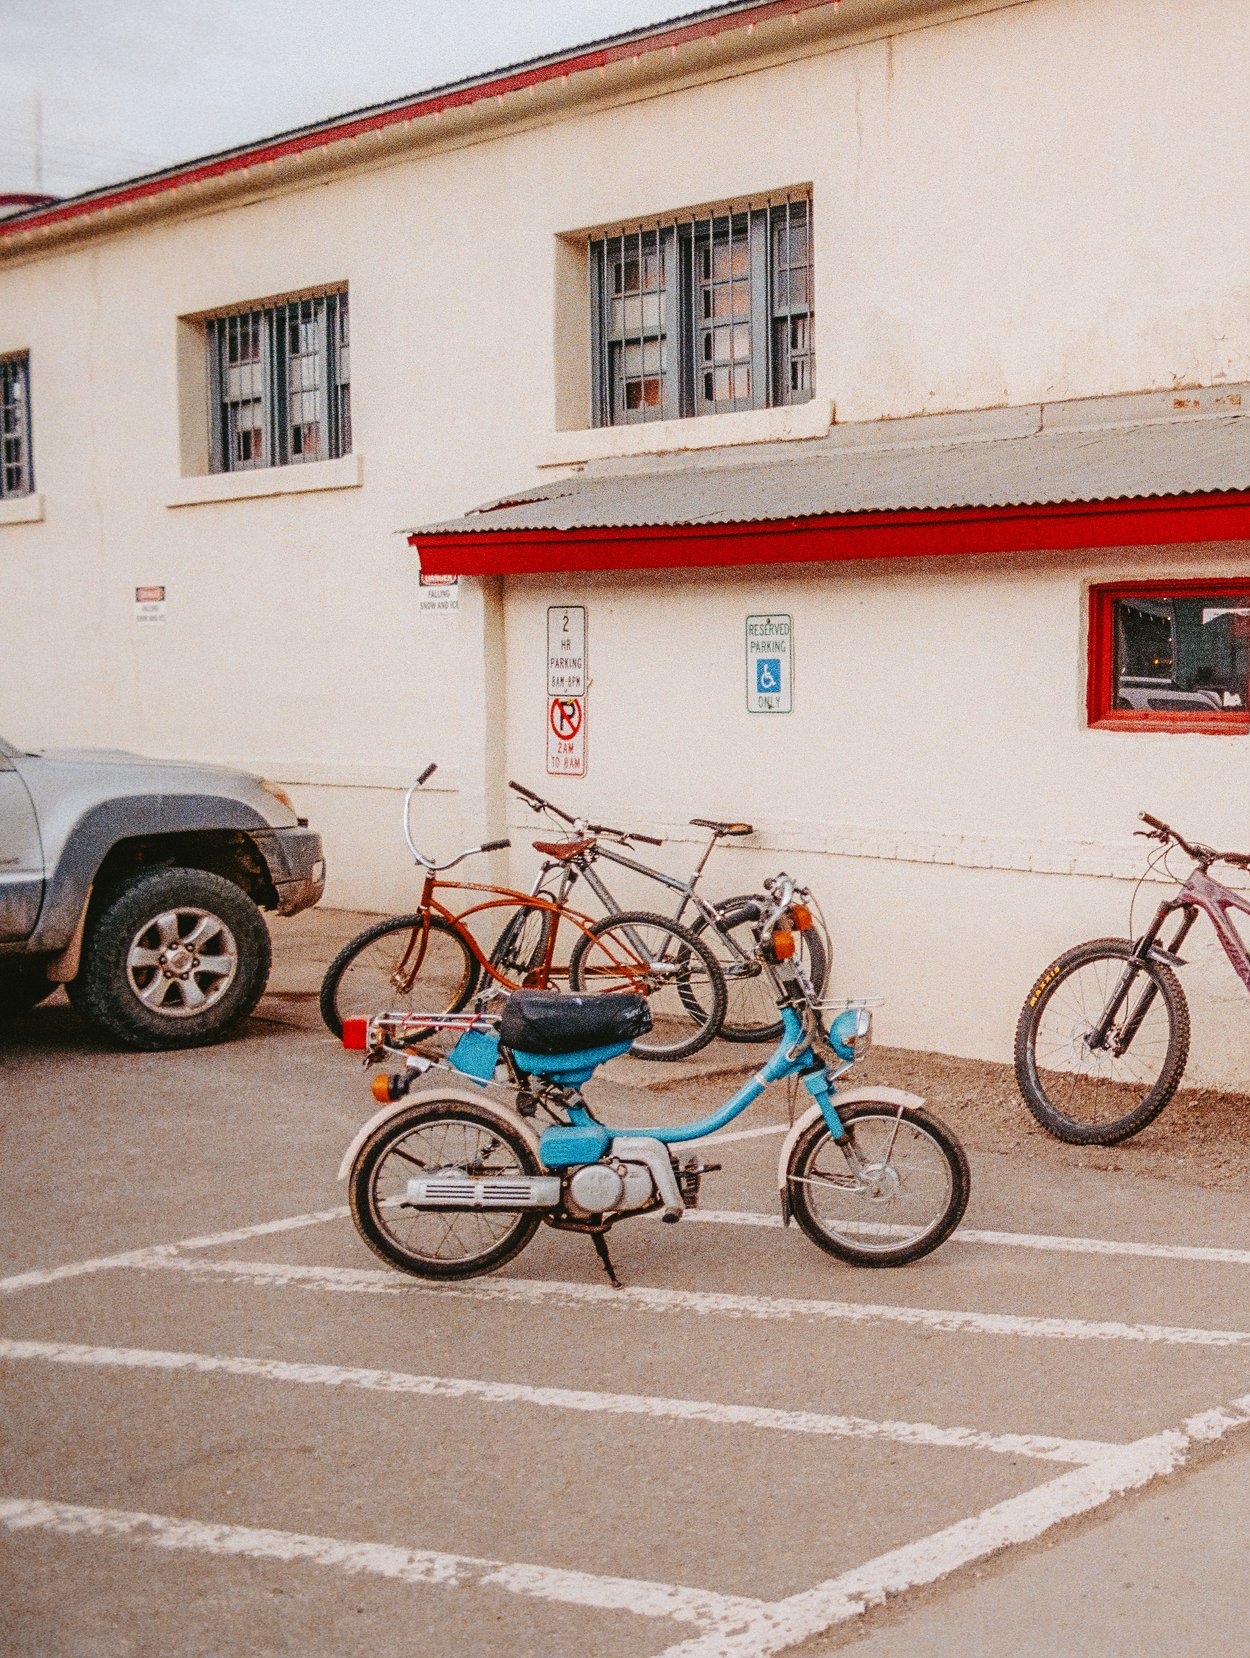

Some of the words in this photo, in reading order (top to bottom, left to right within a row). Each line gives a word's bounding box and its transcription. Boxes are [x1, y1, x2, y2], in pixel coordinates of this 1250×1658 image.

[562, 615, 570, 633] 2
[748, 623, 789, 636] RESERVED
[560, 640, 572, 651] HR
[750, 640, 786, 653] PARKING
[550, 657, 582, 670] PARKING
[758, 696, 781, 708] ONLY
[557, 742, 574, 754] 2AM
[551, 756, 561, 769] TO
[1030, 965, 1060, 1007] MAXXIS
